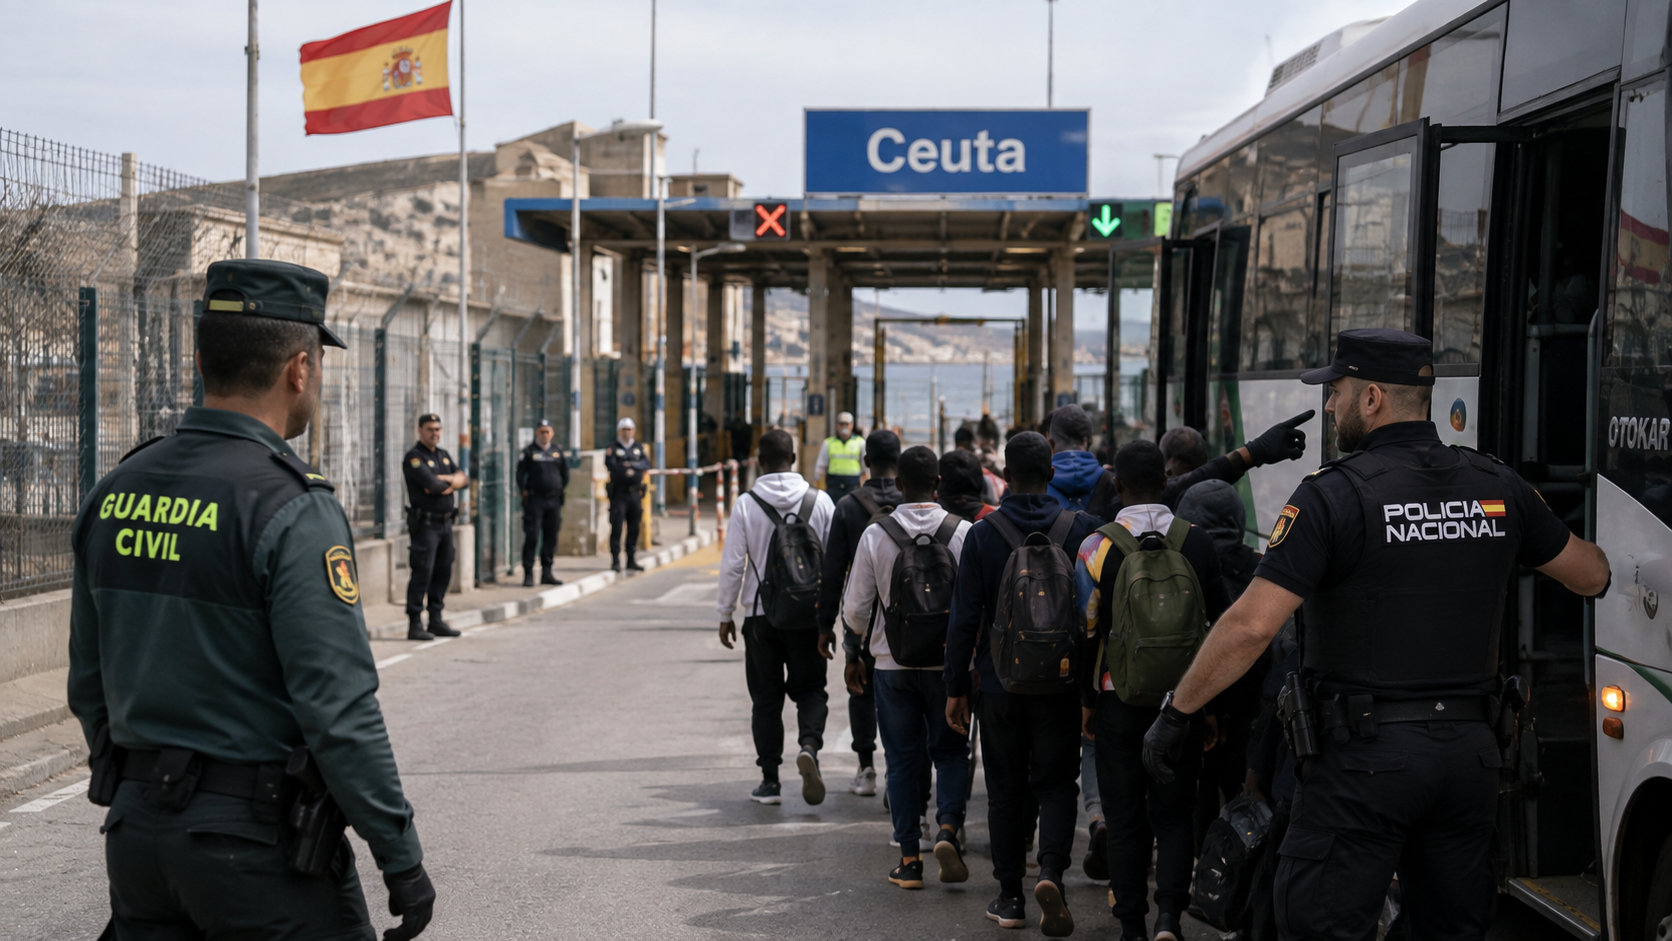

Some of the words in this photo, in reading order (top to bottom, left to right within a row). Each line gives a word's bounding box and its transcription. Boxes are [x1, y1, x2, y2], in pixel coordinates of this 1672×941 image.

[867, 127, 1026, 173] Ceuta
[1608, 416, 1670, 451] OTOKAR
[99, 493, 218, 531] GUARDIA
[1383, 500, 1486, 522] POLICIA
[115, 528, 181, 562] CIVIL
[1386, 519, 1506, 543] NACIONAL
